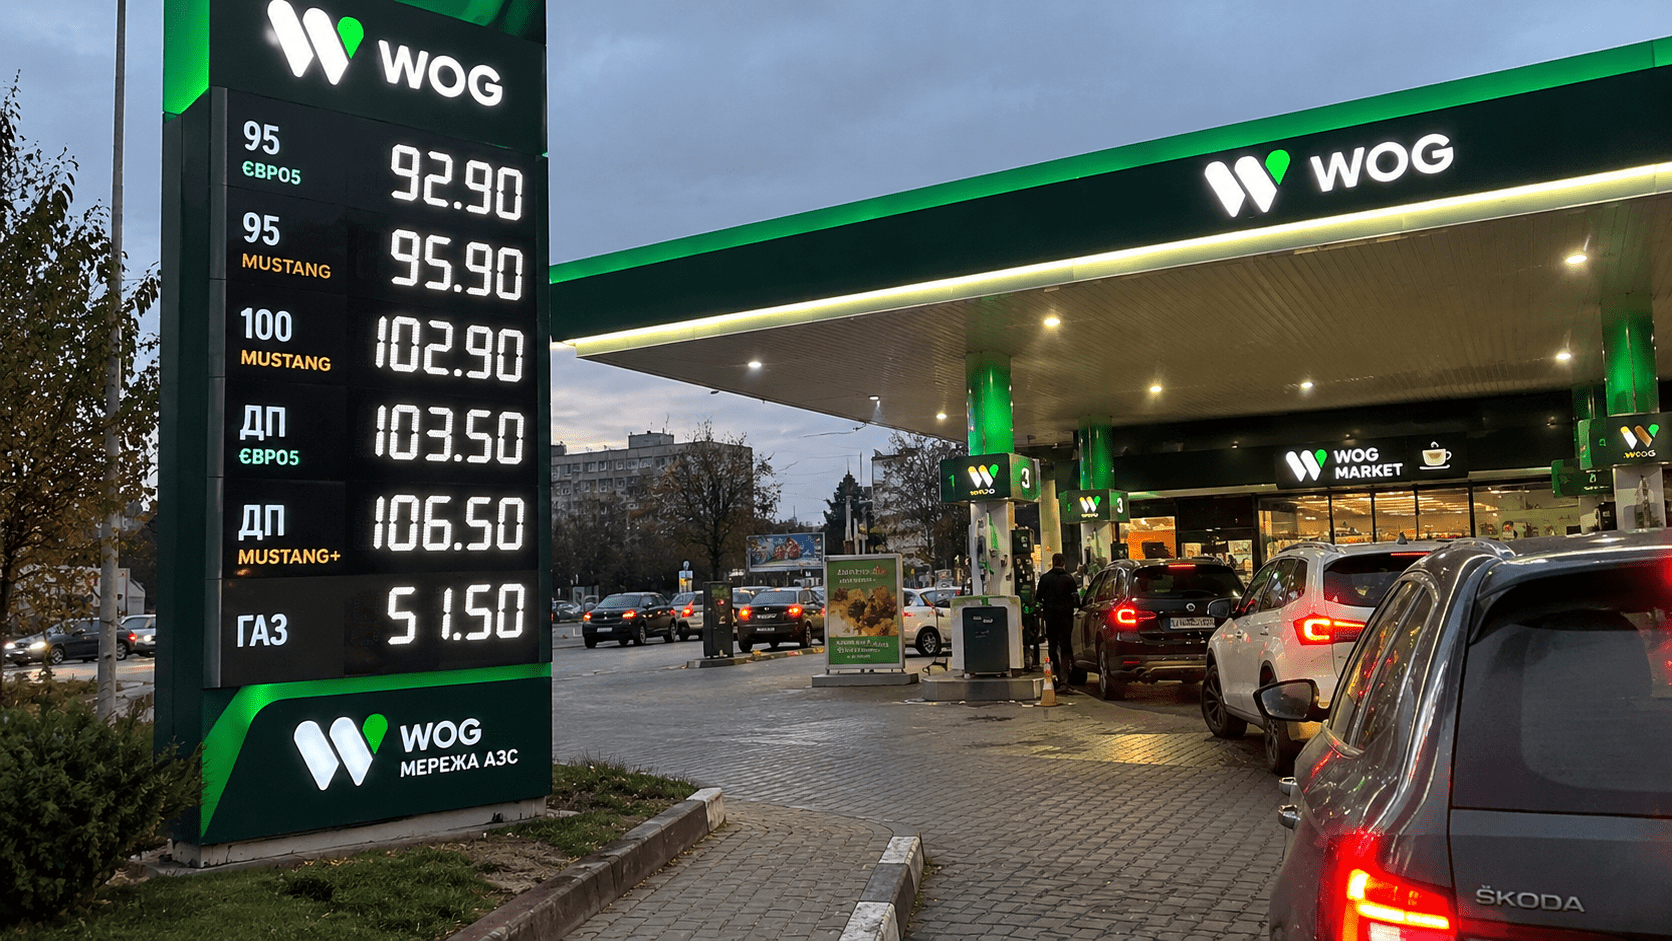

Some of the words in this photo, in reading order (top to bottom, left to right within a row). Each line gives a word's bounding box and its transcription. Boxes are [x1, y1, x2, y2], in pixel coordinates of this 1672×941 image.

[378, 39, 503, 106] WOG
[243, 120, 280, 155] 95
[242, 160, 301, 185] ЄВРО5
[1309, 133, 1454, 192] WOG
[391, 144, 523, 220] 92.90
[243, 211, 280, 246] 95
[242, 253, 331, 279] MUSTANG
[391, 229, 523, 300] 95.90
[240, 307, 293, 342] 100
[241, 349, 332, 372] MUSTANG
[375, 315, 524, 382] 102.90
[239, 404, 286, 441] ДП
[375, 404, 524, 465] 103.50
[239, 448, 300, 466] ЄВРО5
[1333, 447, 1380, 464] WOG
[1335, 463, 1404, 480] MARKET
[1021, 467, 1030, 489] 3
[238, 504, 285, 541] ДП
[373, 494, 525, 552] 106.50
[1116, 497, 1124, 514] 3
[238, 548, 341, 565] MUSTANG+
[237, 613, 288, 648] ГАЗ
[400, 717, 482, 752] WOG
[400, 755, 480, 778] МЕРЕЖА
[484, 748, 519, 768] АЗС
[1476, 885, 1585, 913] ŠKODA
